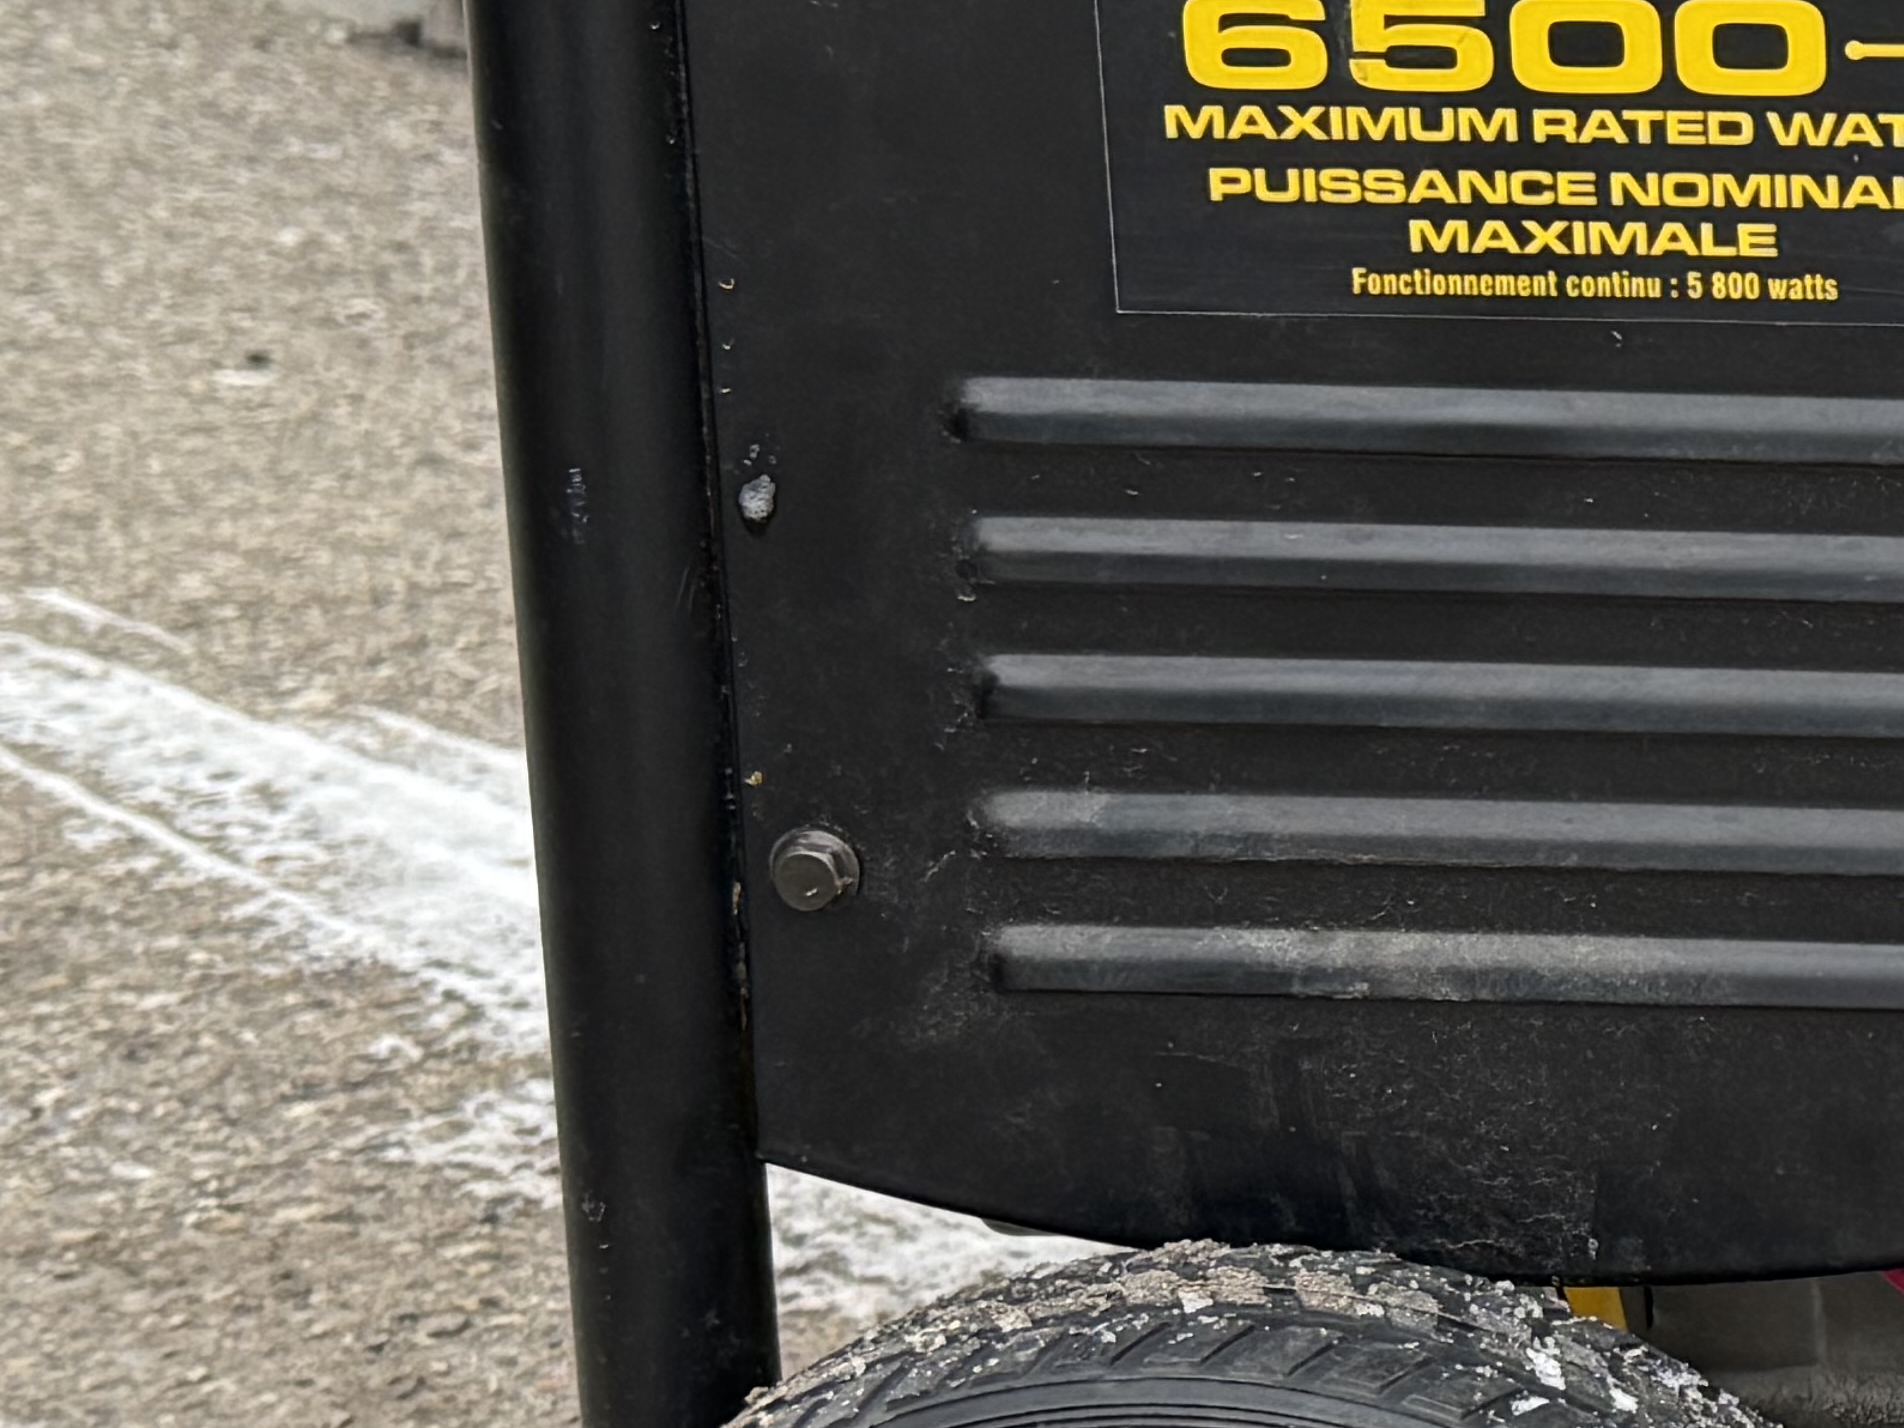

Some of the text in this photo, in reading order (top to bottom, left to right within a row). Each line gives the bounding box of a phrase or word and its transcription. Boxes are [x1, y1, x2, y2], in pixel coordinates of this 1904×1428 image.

[1163, 104, 1518, 142] MAXIMUM
[1532, 108, 1754, 145] RATED
[1208, 167, 1597, 205] PUISSANCE
[1408, 219, 1778, 257] MAXIMALE
[1351, 267, 1558, 296] Fonctionnement
[1565, 270, 1661, 298] continu
[1686, 270, 1703, 299] 5
[1711, 271, 1760, 300] 800
[1767, 273, 1838, 300] watts
